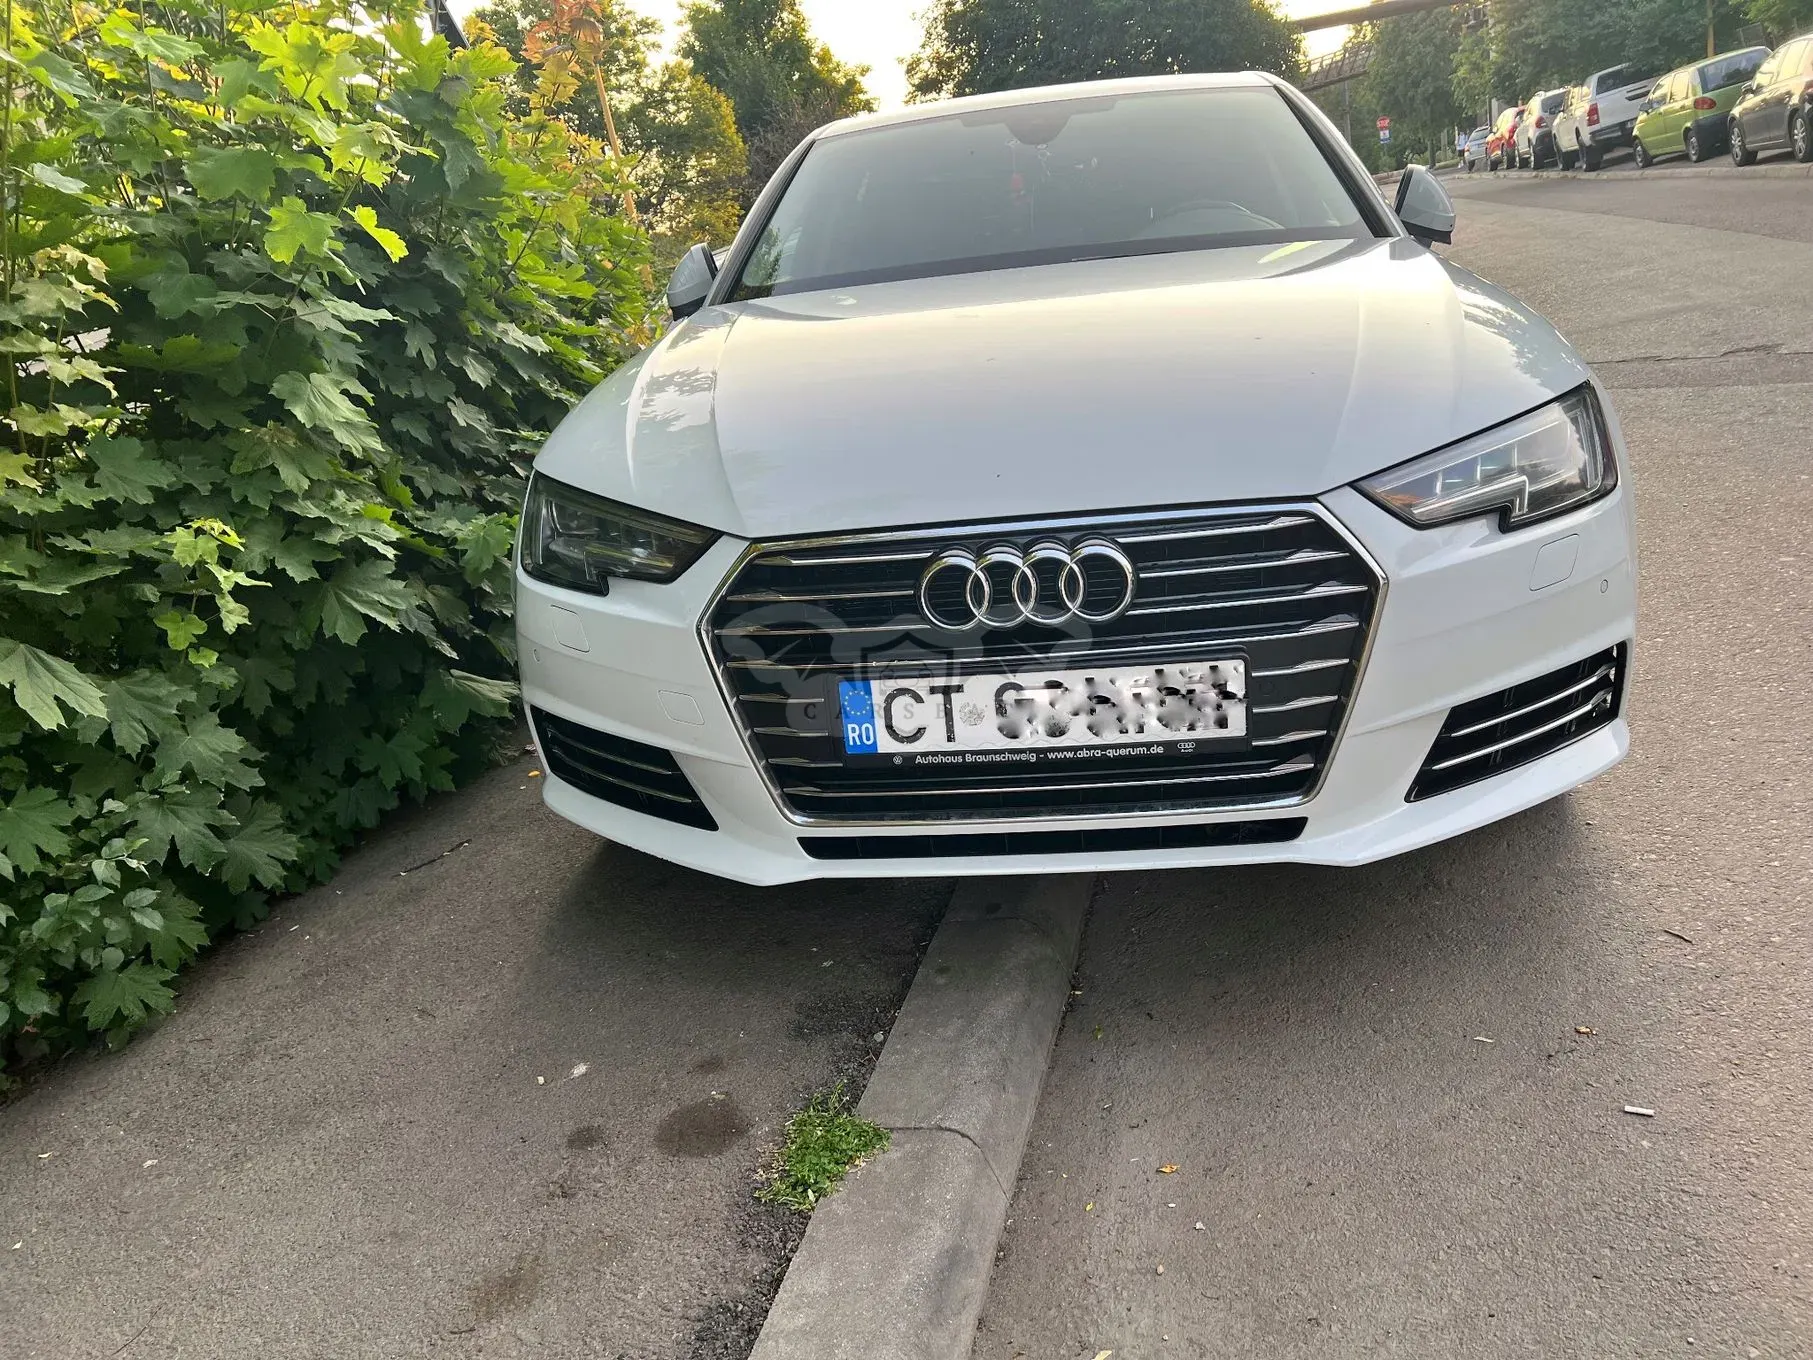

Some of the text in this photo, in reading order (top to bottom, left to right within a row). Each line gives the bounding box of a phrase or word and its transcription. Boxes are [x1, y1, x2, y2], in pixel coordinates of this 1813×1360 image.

[883, 683, 965, 744] CT
[847, 723, 875, 746] RO
[914, 753, 963, 765] Autohaus
[965, 750, 1037, 763] Braunschweig
[1047, 744, 1164, 760] www.abra-querum.de
